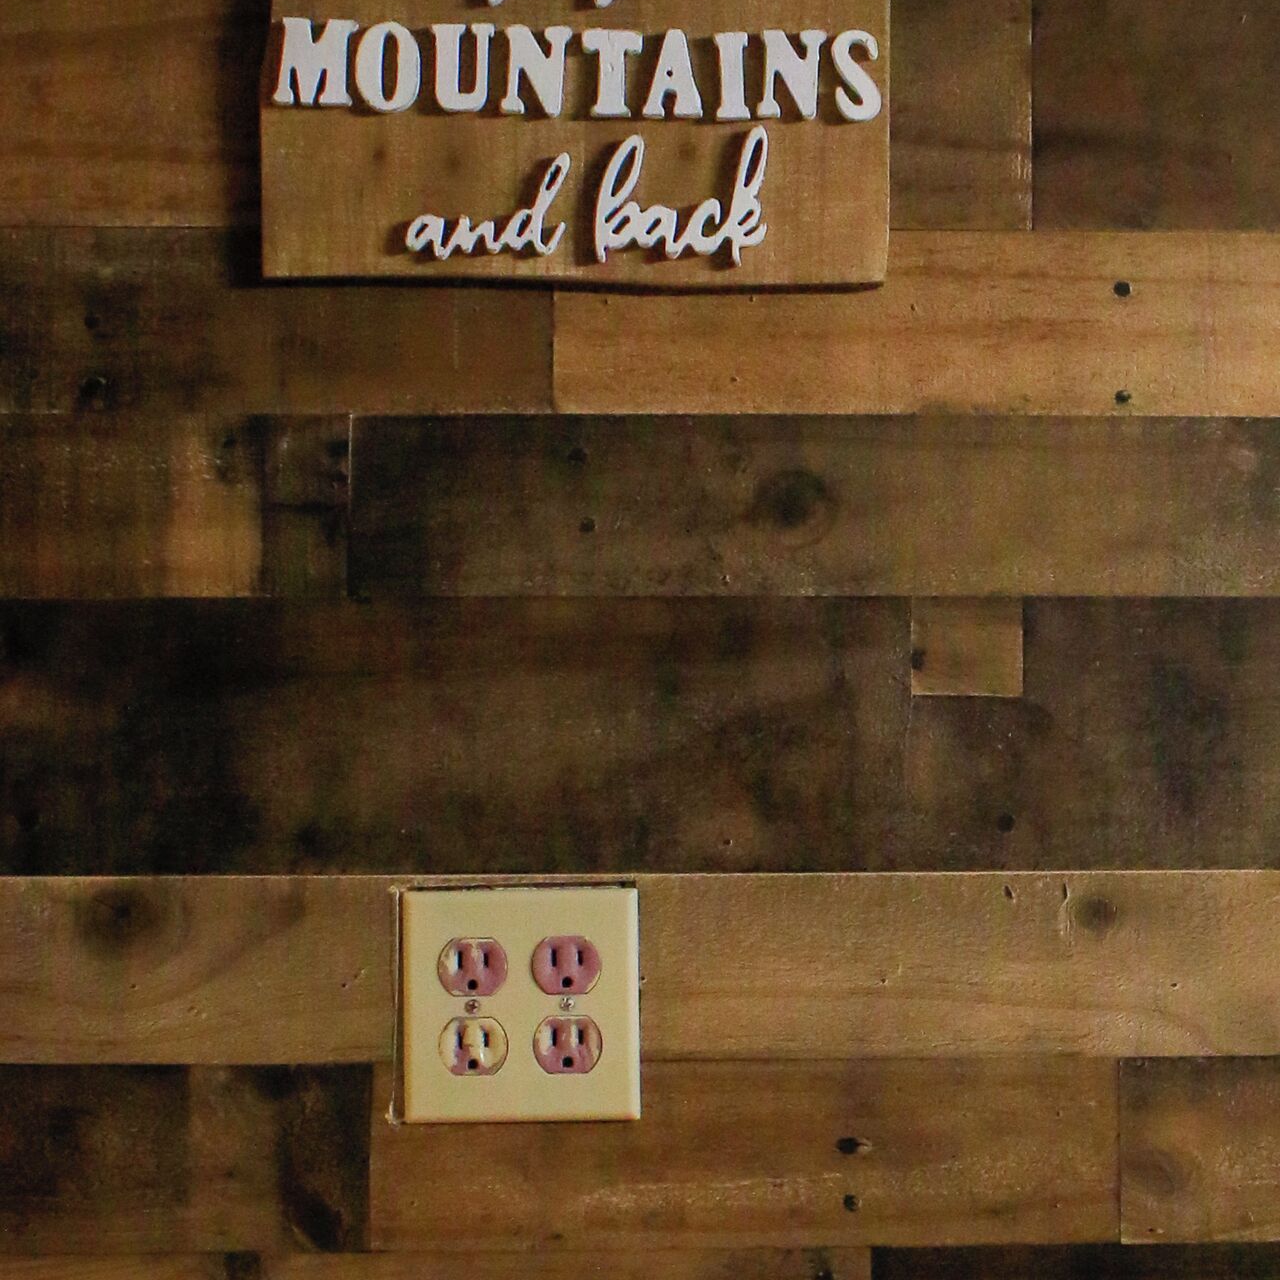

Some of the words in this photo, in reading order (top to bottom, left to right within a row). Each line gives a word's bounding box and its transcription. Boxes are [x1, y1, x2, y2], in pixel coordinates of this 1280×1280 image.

[272, 17, 882, 122] MOUNTAINS
[404, 152, 571, 260] and
[594, 125, 768, 267] back
